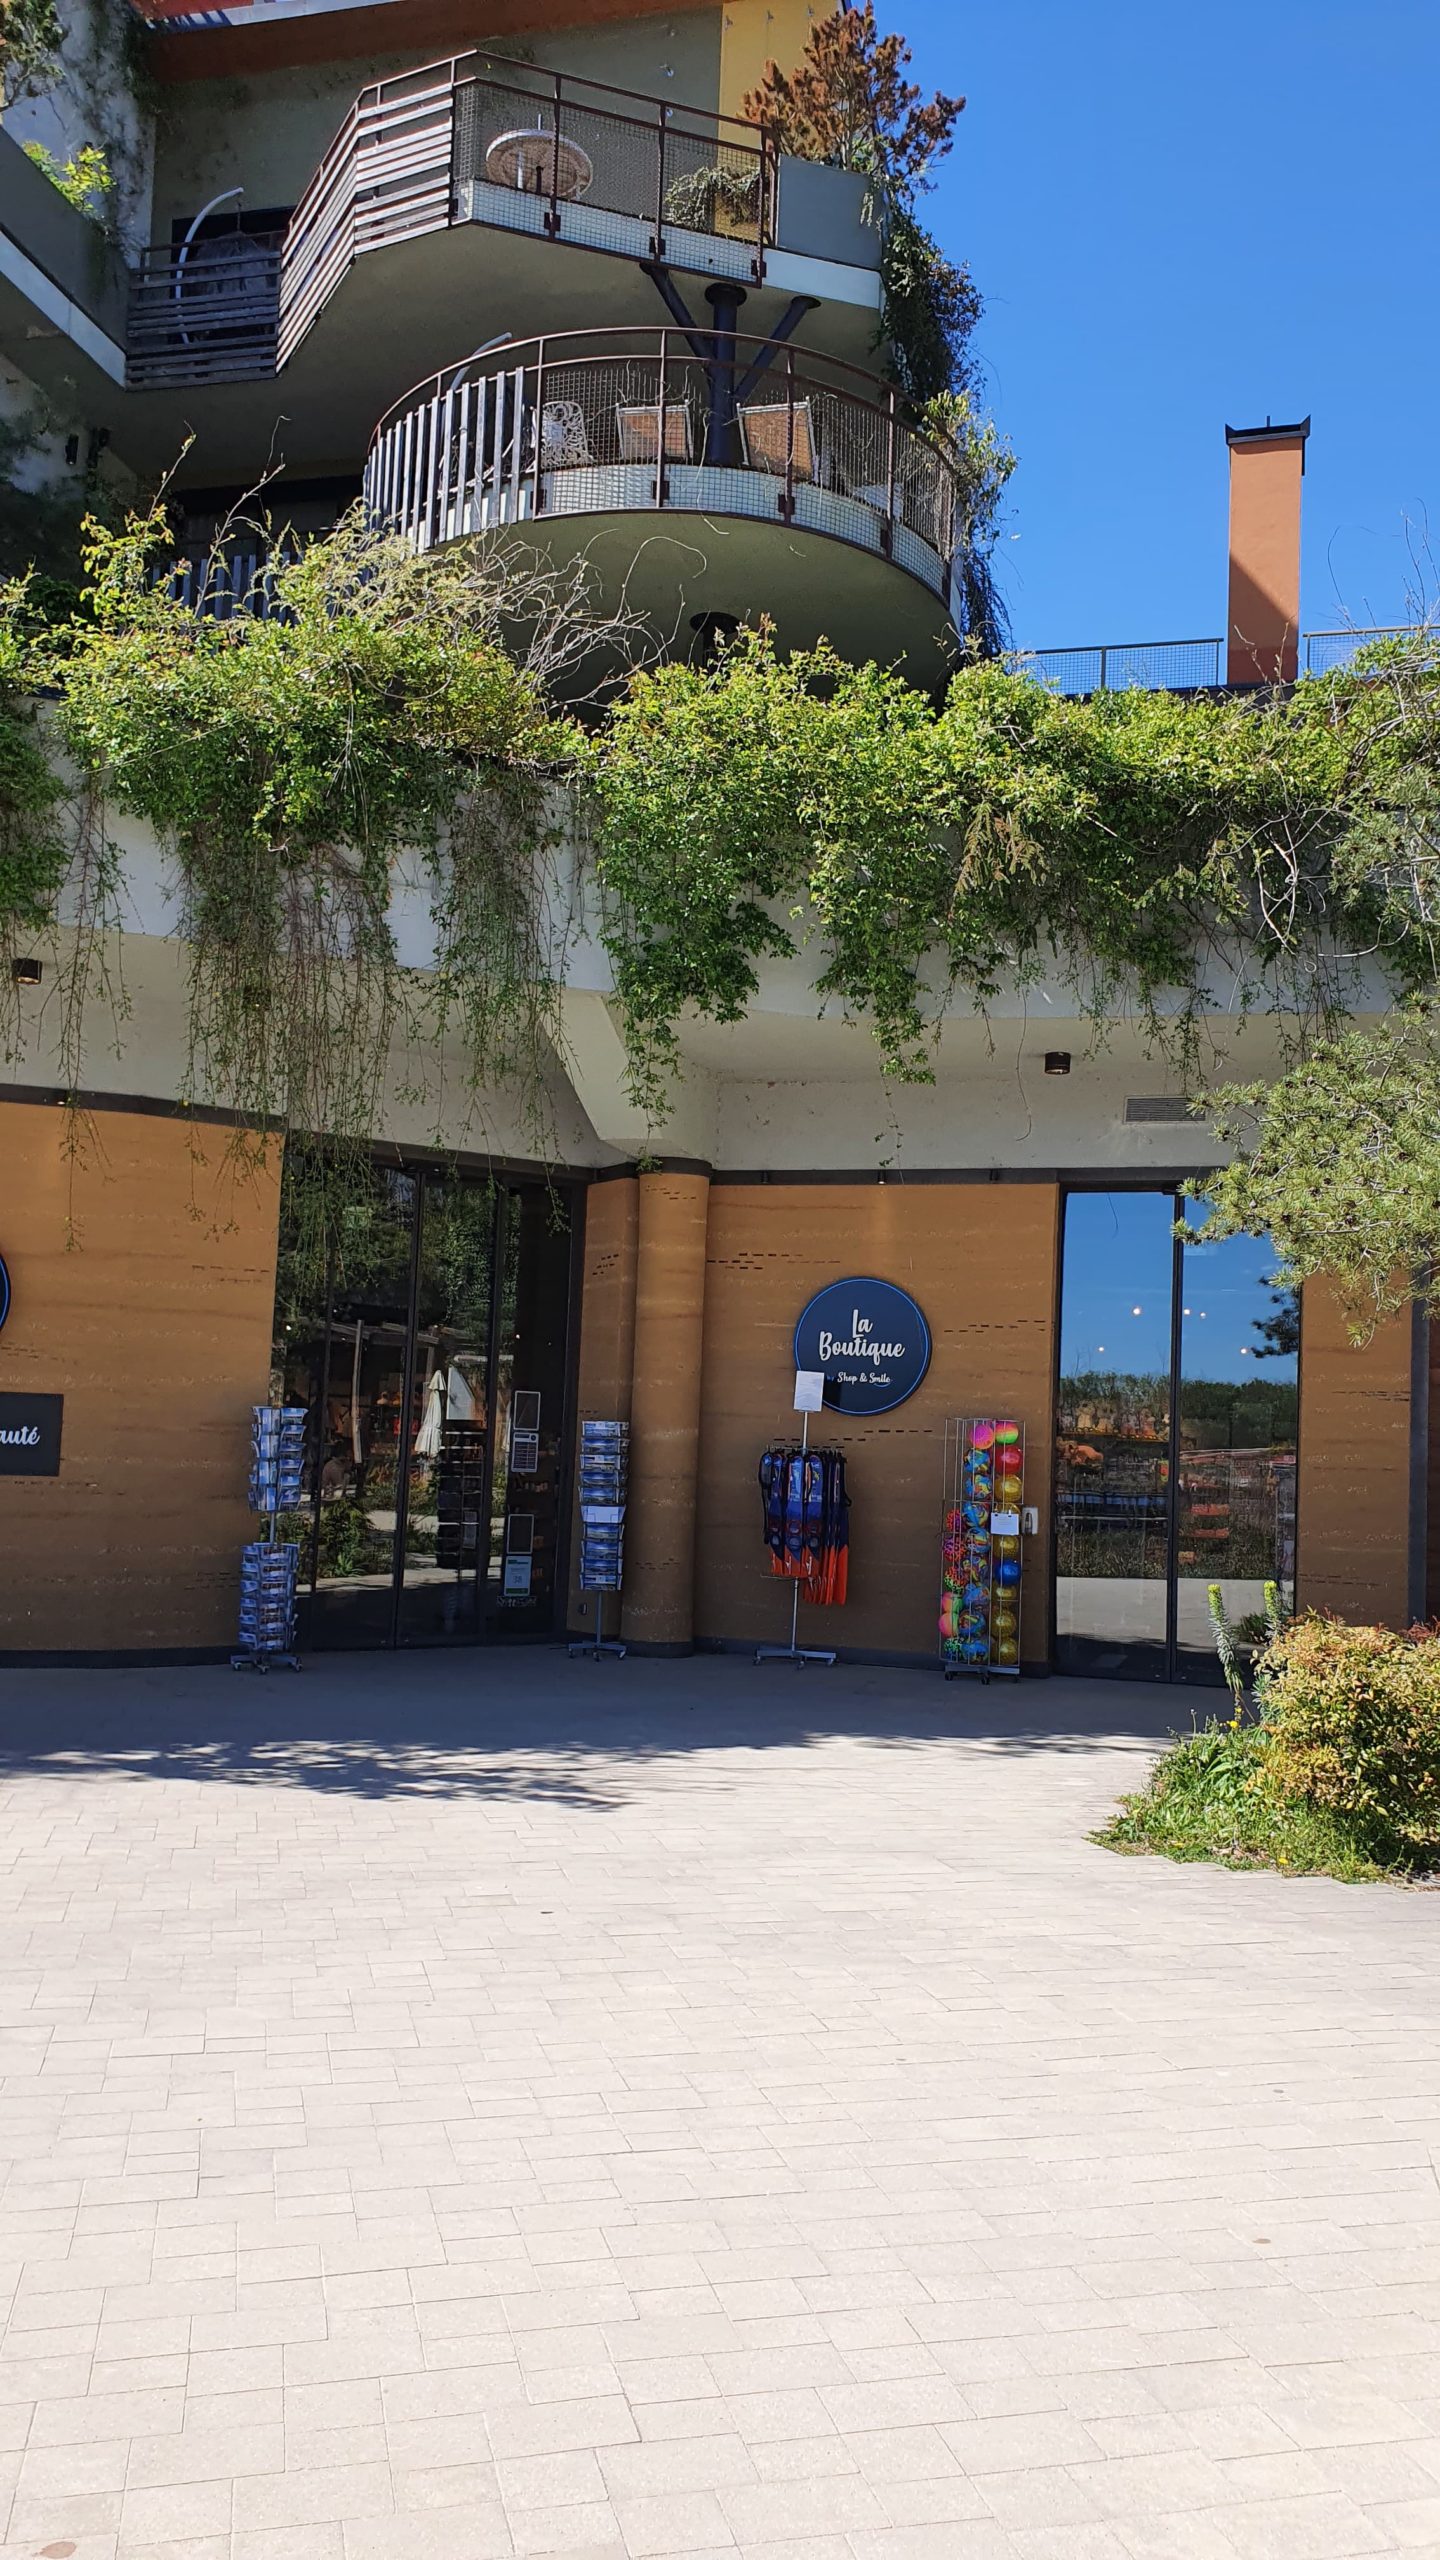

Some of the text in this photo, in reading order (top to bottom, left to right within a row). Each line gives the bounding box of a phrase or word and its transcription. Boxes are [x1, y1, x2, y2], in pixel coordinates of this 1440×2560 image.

[852, 1309, 873, 1338] La
[819, 1331, 905, 1365] Boutique
[837, 1371, 857, 1385] Shop
[859, 1372, 868, 1382] &
[869, 1372, 891, 1383] Smile
